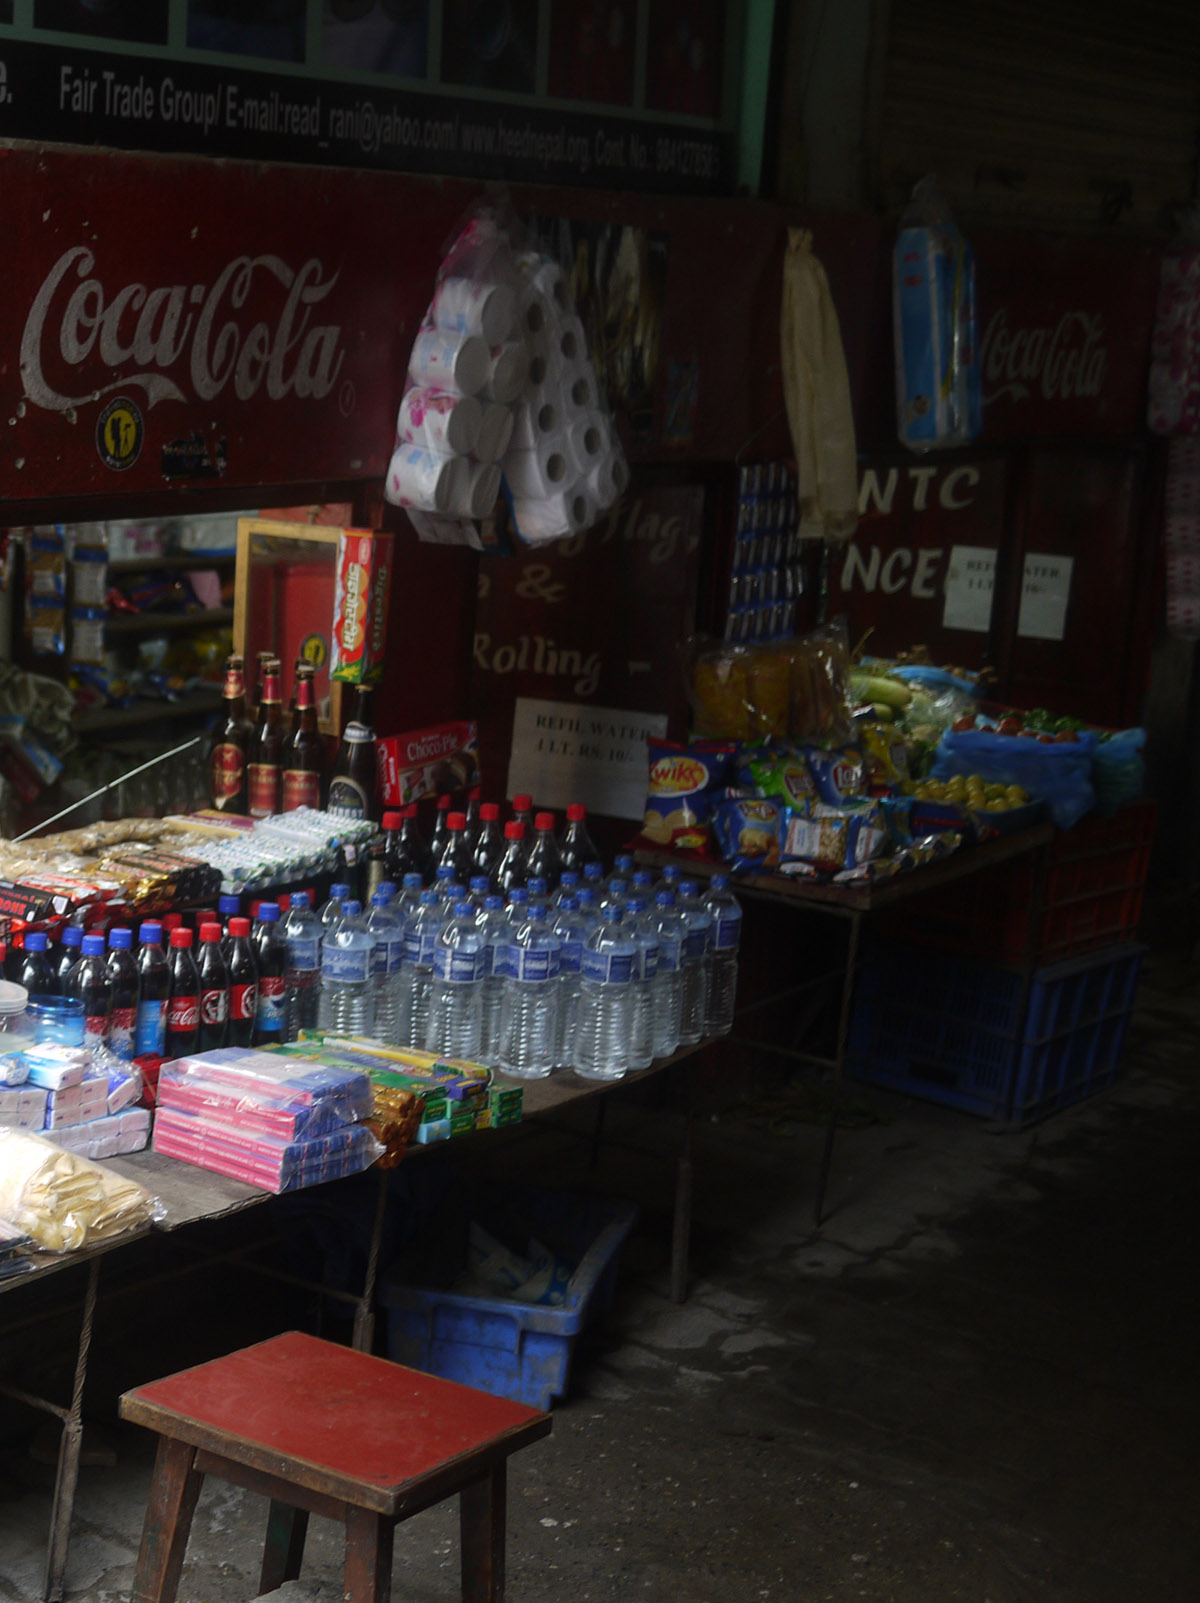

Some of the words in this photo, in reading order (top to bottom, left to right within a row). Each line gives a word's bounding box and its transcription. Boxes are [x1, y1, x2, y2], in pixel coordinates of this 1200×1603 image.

[60, 65, 98, 115] Fair
[102, 71, 154, 121] Trade
[19, 246, 346, 412] Coca-Cola
[473, 632, 603, 697] Rolling
